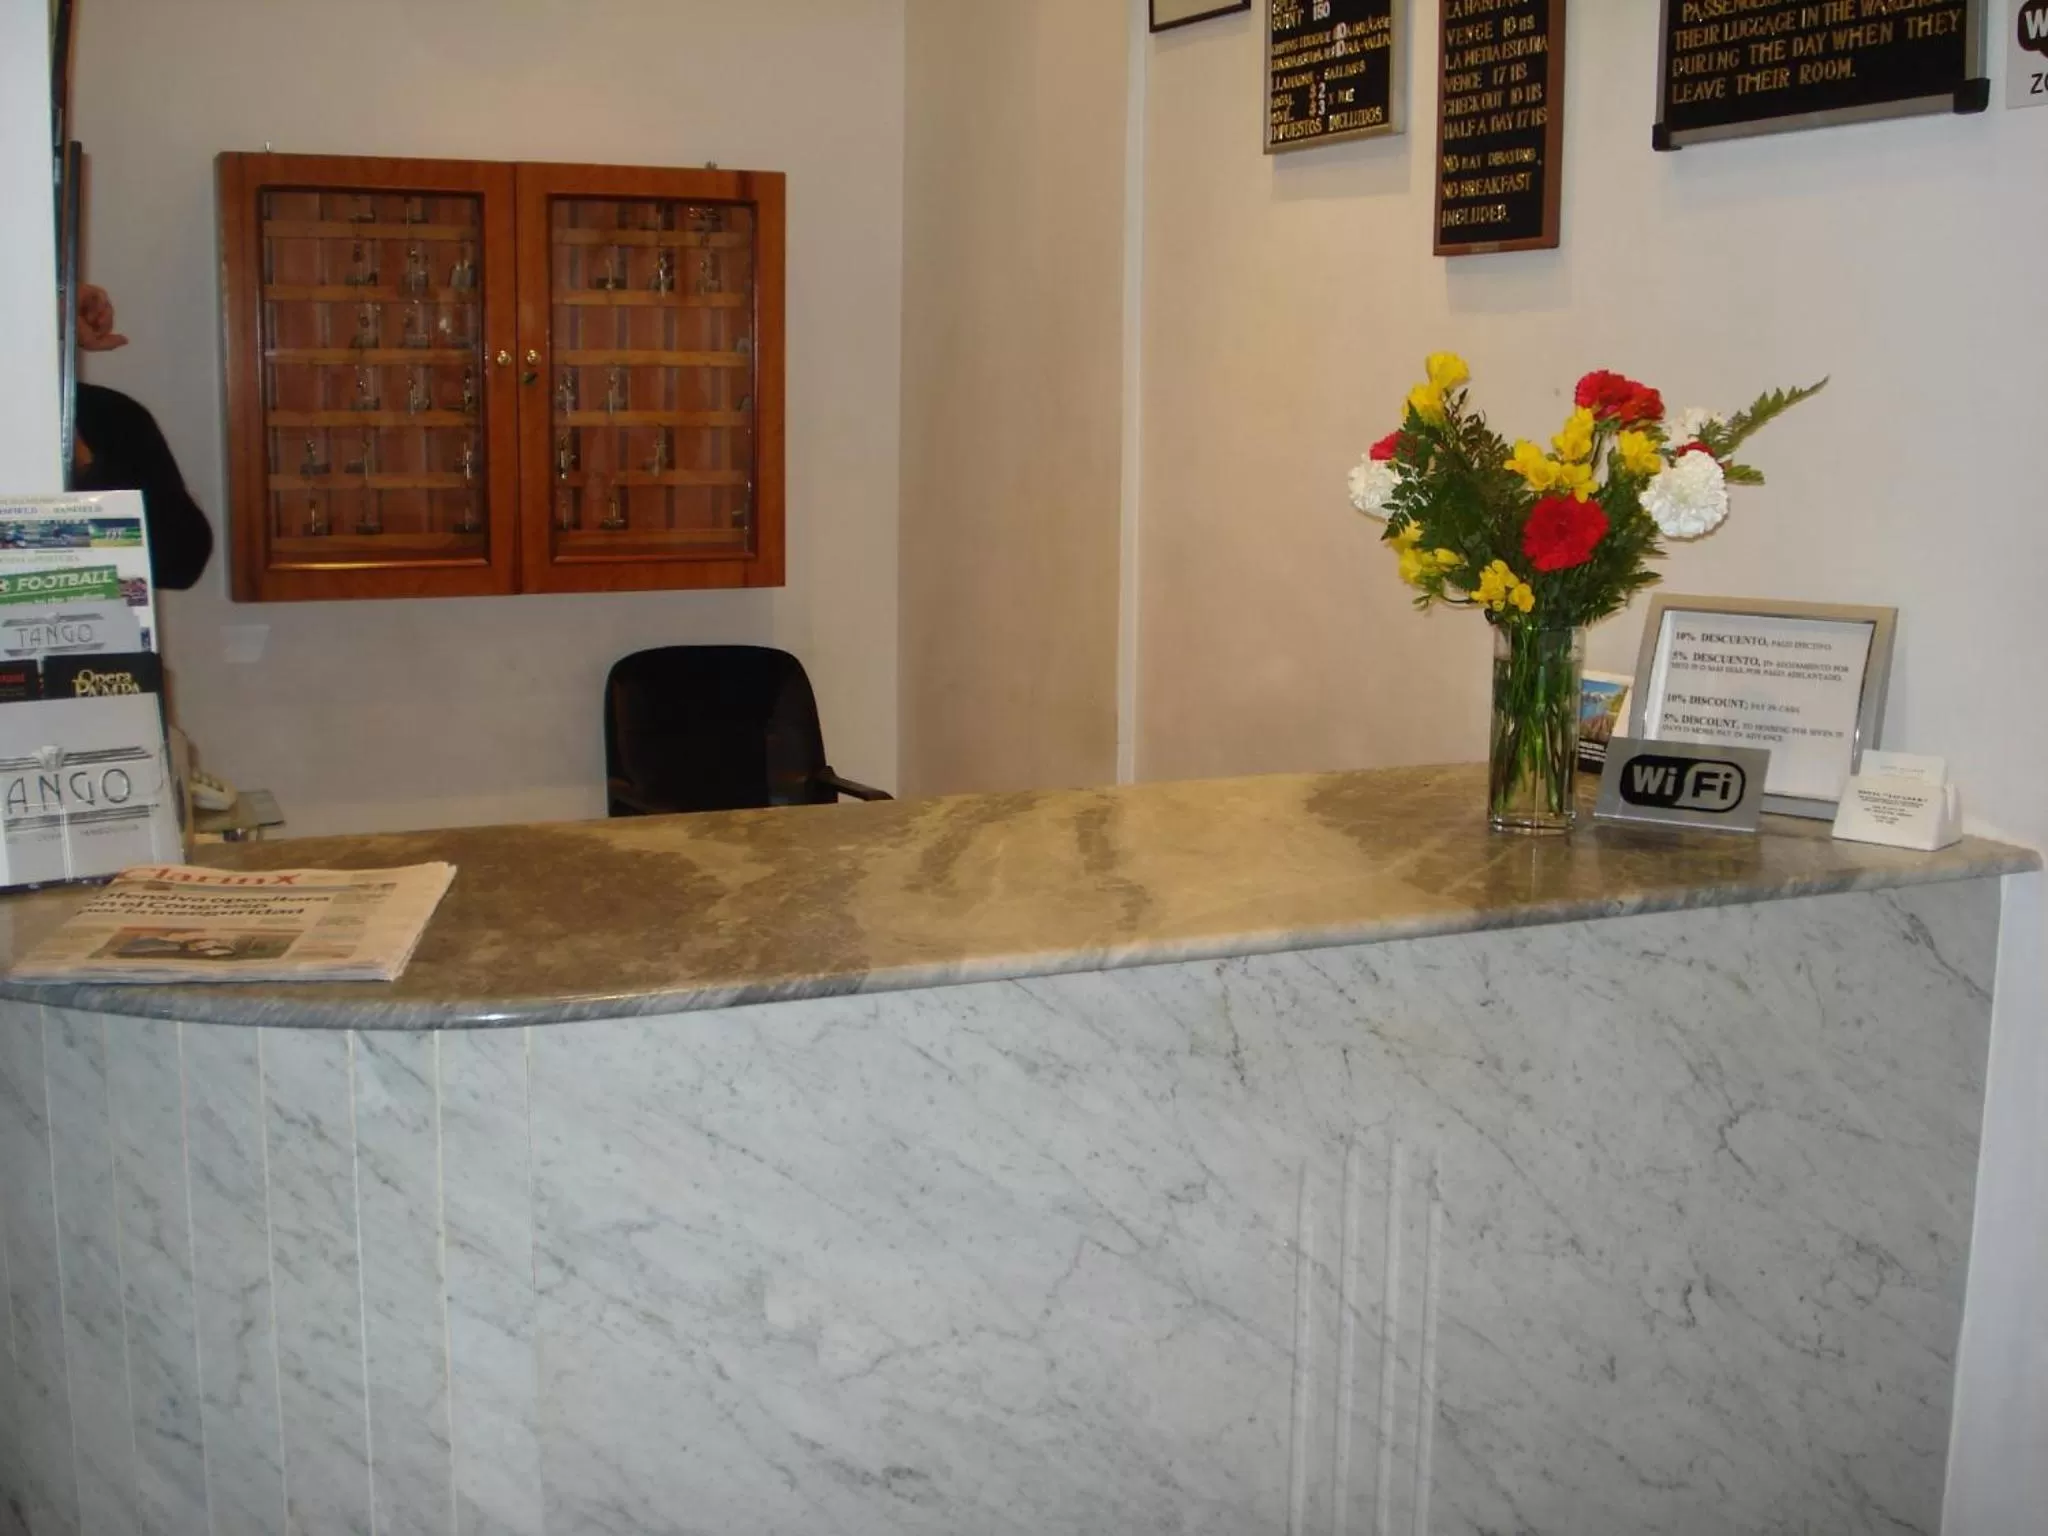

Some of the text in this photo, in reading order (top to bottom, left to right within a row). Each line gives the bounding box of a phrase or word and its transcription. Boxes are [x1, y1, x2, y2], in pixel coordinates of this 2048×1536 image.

[1447, 20, 1494, 46] VENCE
[1673, 24, 1720, 51] THEIR
[1724, 11, 1797, 41] LUGGAGE
[1802, 7, 1819, 28] IN
[1822, 0, 1856, 26] THE
[1672, 48, 1740, 77] DURING
[1749, 39, 1787, 65] THE
[1792, 31, 1827, 57] DAY
[1832, 21, 1893, 50] WHEN
[1905, 8, 1961, 40] THEY
[1445, 51, 1462, 70] LA
[1443, 71, 1483, 92] VENCE
[1493, 65, 1507, 85] 17
[1672, 56, 1857, 104] LEAVE THEIR ROOM.
[1444, 118, 1476, 140] HALF
[1476, 117, 1488, 137] A
[1491, 111, 1514, 133] DAY
[1443, 154, 1459, 173] NO
[1443, 171, 1532, 200] NO BREAKFAST
[17, 568, 113, 591] FOOTBALL
[14, 623, 93, 648] TANGO
[1675, 631, 1697, 641] 10%
[1667, 693, 1687, 704] 10%
